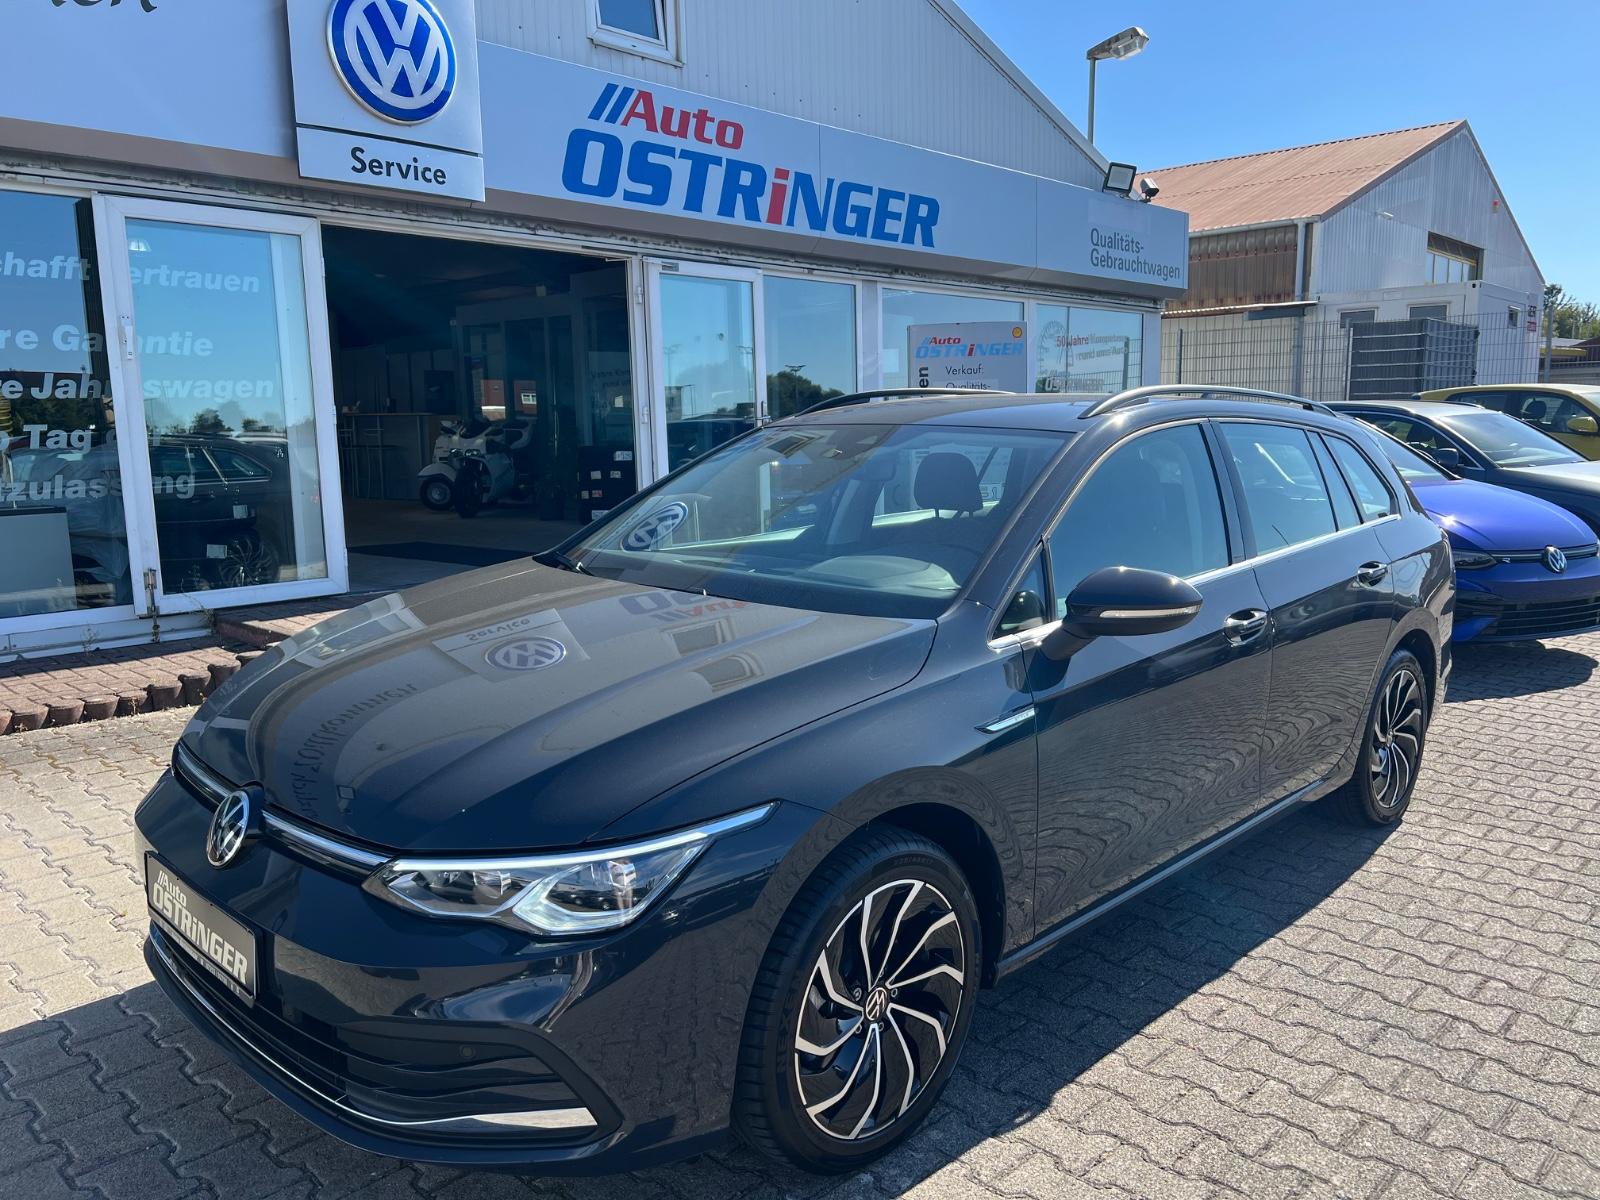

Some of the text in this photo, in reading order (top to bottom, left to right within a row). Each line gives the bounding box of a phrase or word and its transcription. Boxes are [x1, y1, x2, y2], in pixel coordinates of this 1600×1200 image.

[350, 146, 447, 186] Service
[1090, 227, 1145, 255] Qualitäts-
[0, 252, 260, 294] hafft ertrauen
[1090, 247, 1181, 282] Gebrauchtwagen
[23, 423, 95, 456] Tag
